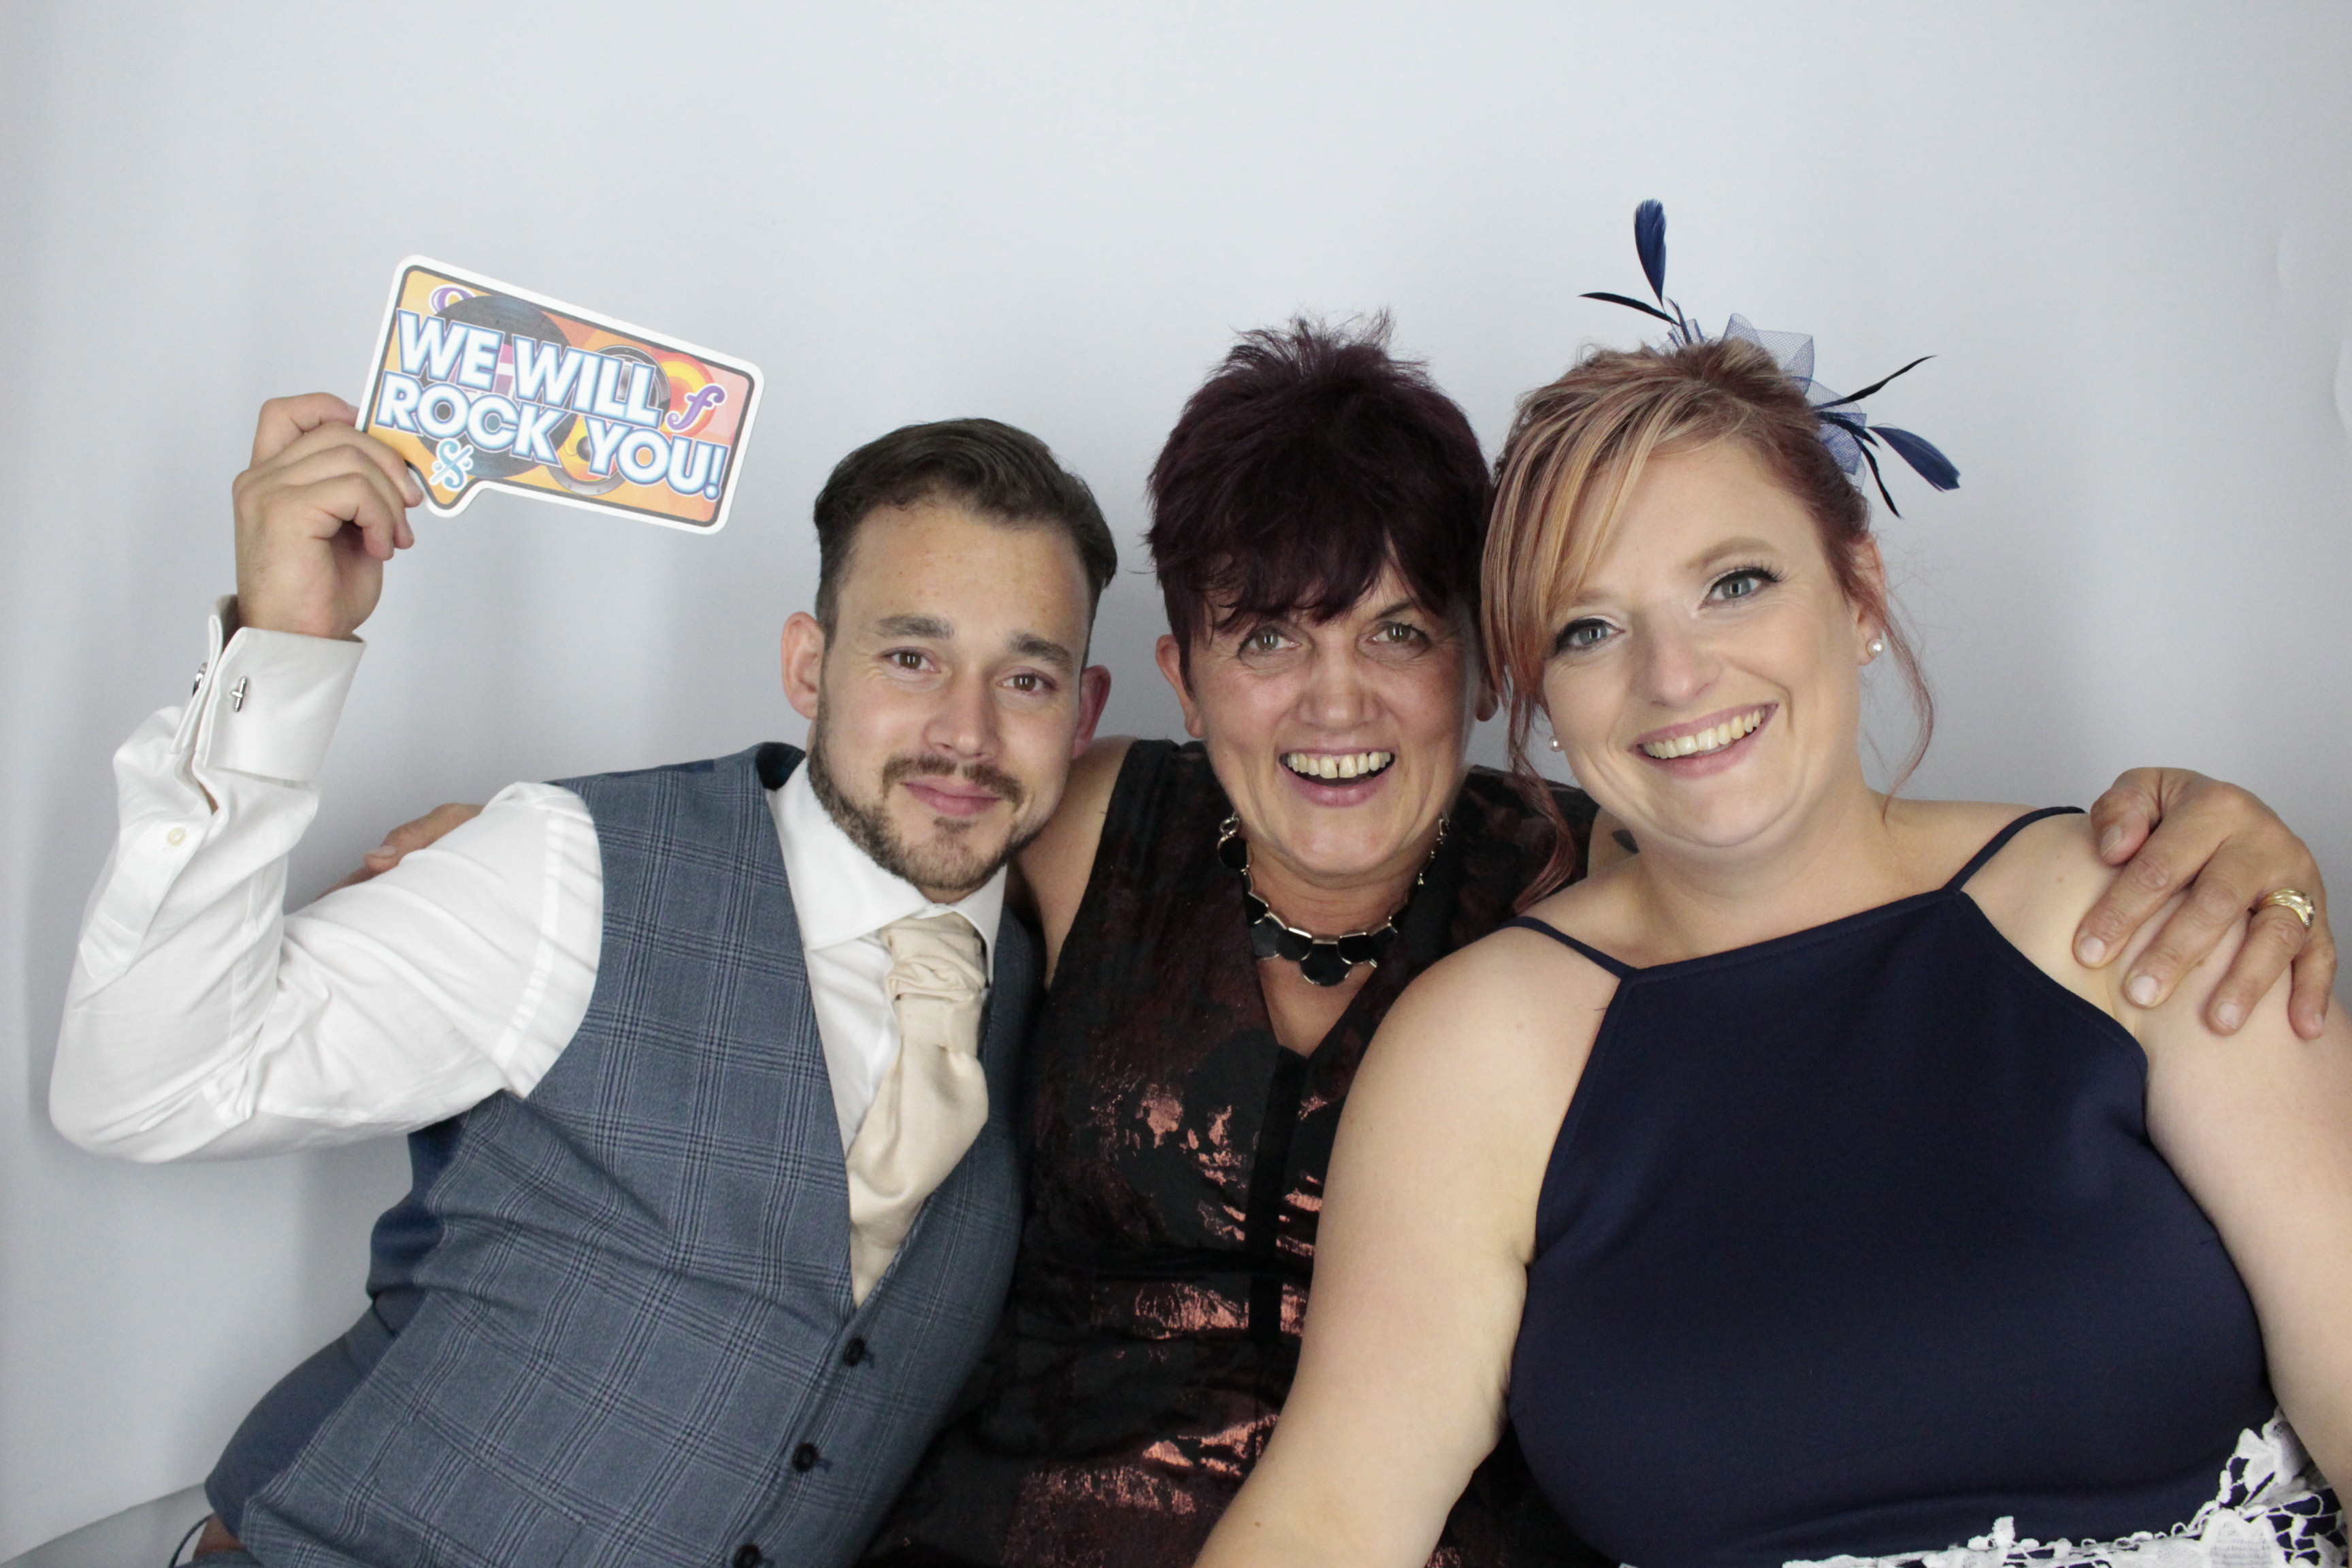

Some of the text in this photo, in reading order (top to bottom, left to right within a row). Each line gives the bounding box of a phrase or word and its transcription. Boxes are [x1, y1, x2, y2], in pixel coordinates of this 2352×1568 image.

[397, 309, 664, 429] WE WILL
[374, 371, 728, 500] ROCK YOU!
